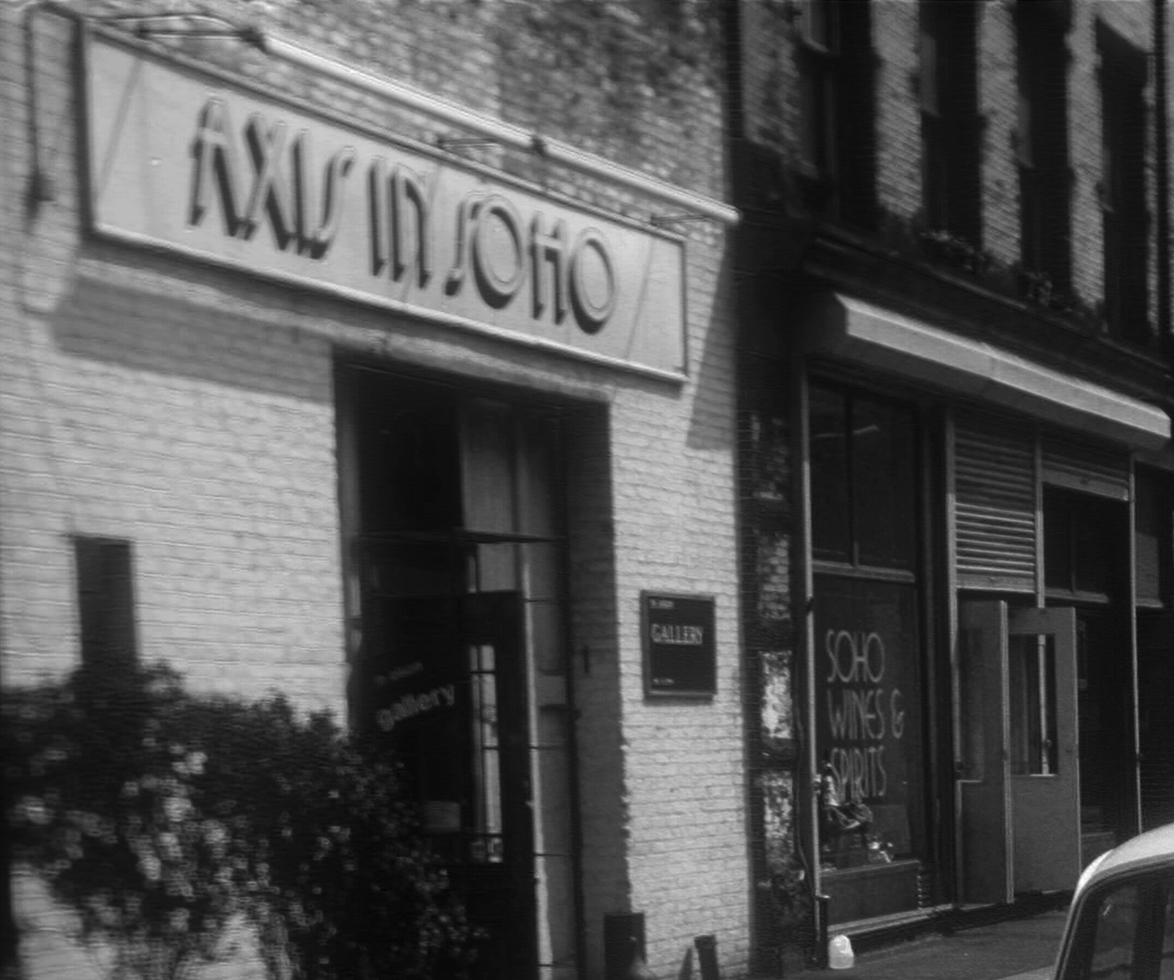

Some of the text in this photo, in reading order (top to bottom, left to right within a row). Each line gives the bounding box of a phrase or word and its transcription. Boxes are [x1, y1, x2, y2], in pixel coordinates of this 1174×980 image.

[187, 96, 617, 335] AXIS IN SOHO
[650, 623, 704, 645] GALLERY
[825, 628, 886, 683] SOHO
[375, 684, 455, 731] gallery
[826, 687, 905, 740] WINES &
[830, 744, 888, 801] SPIRITS
